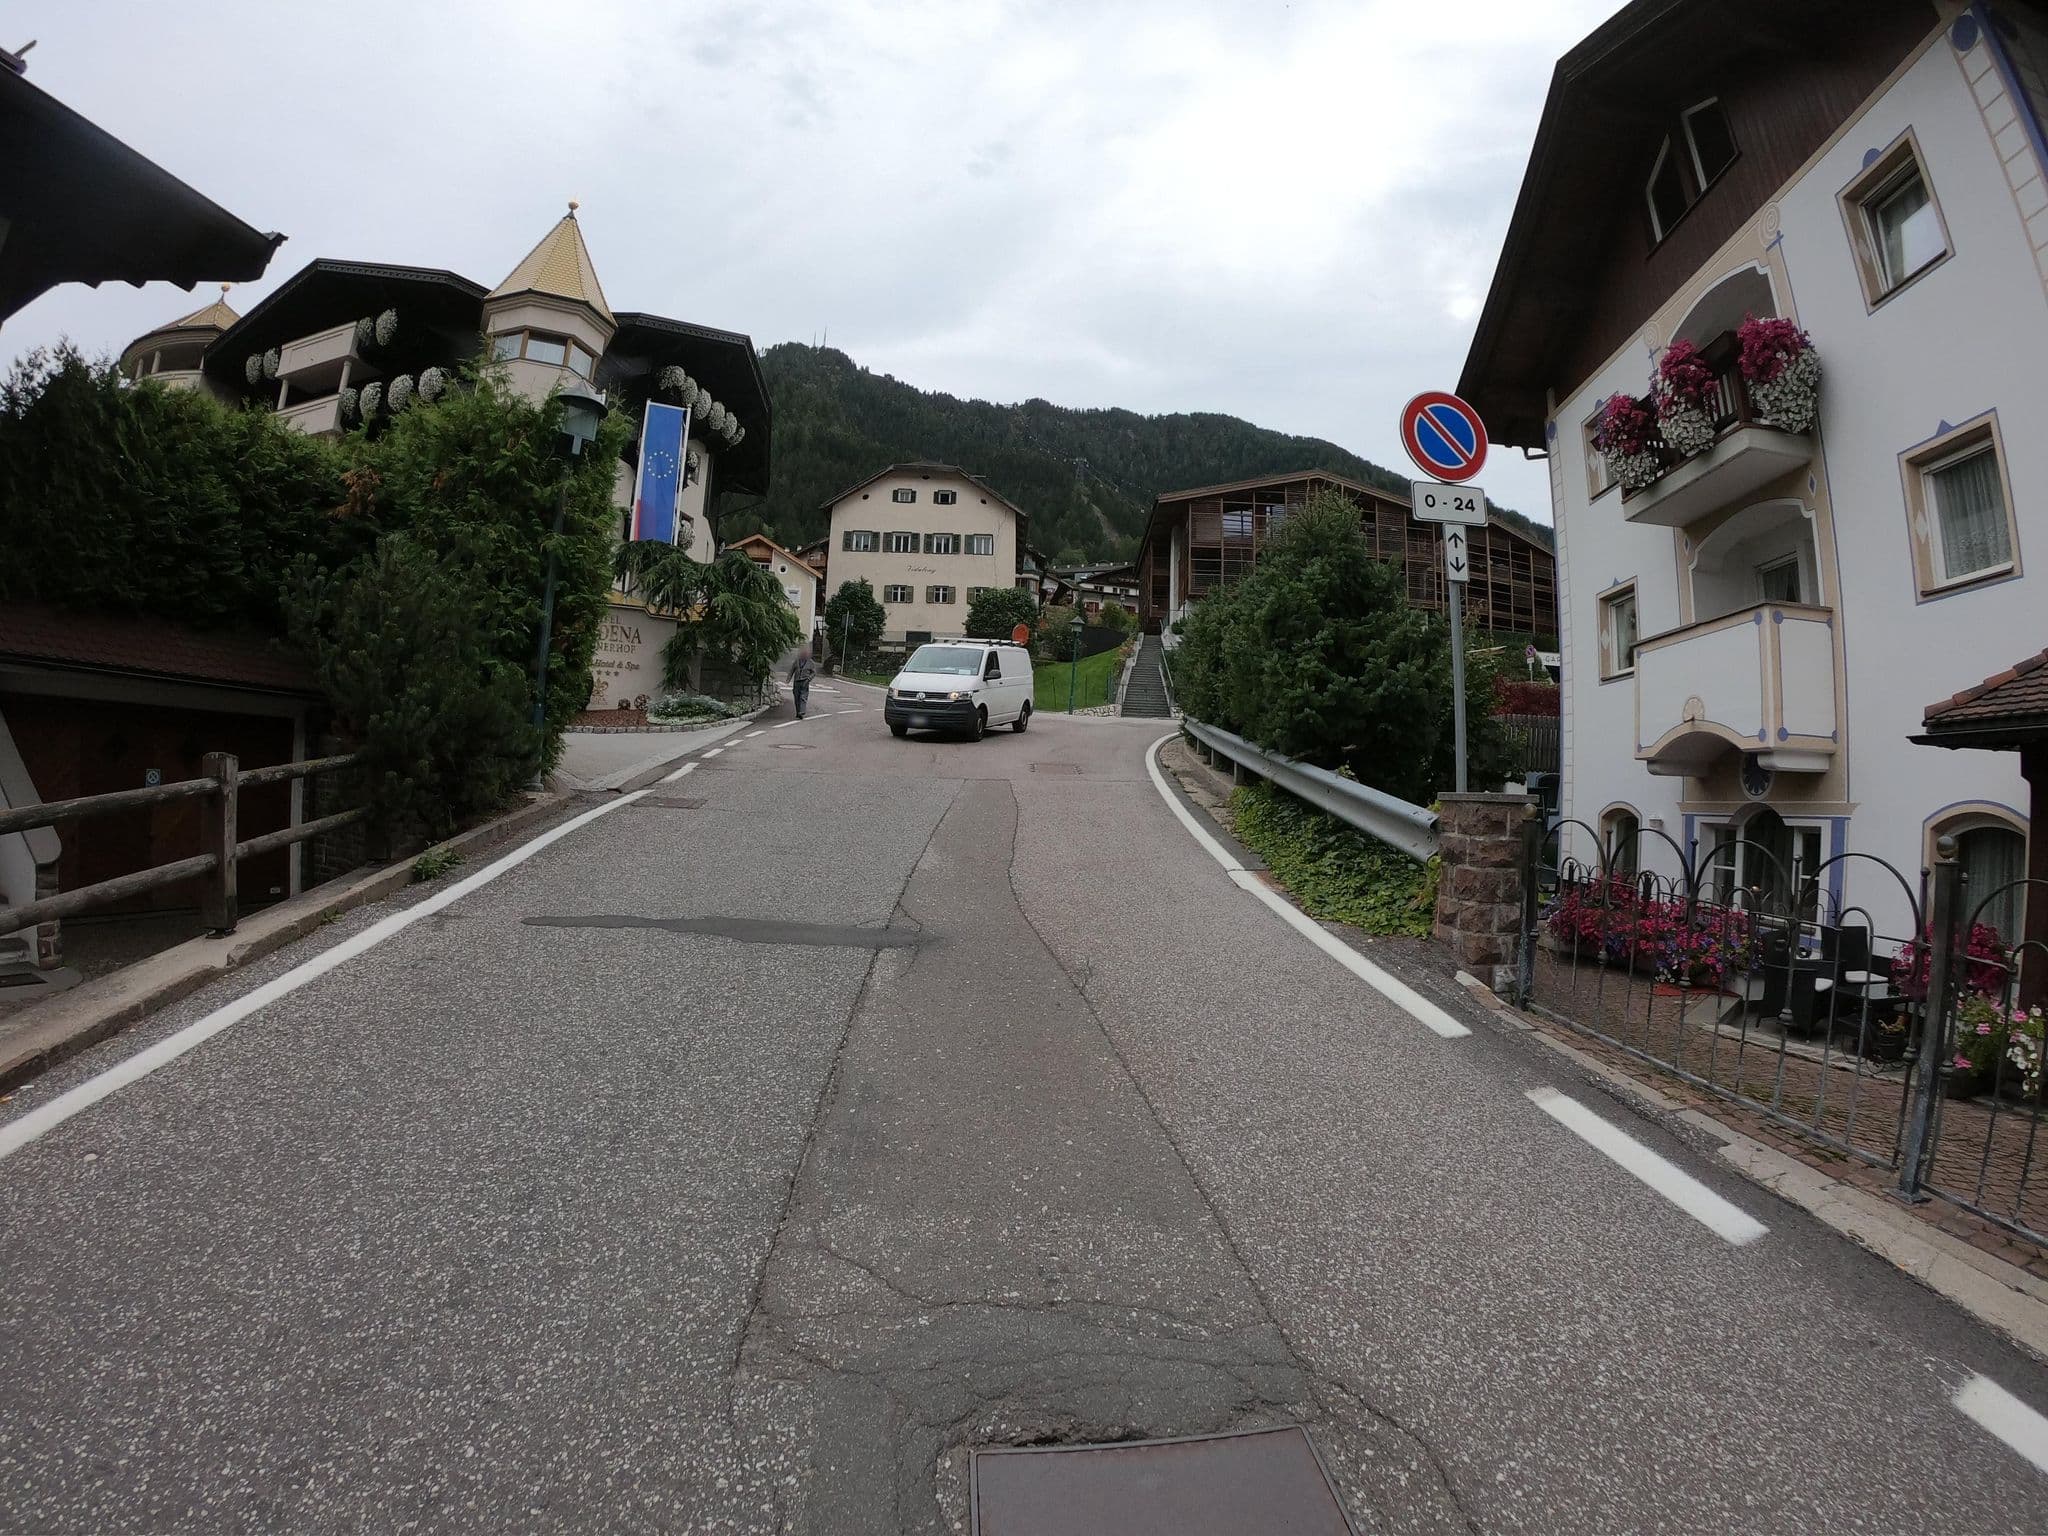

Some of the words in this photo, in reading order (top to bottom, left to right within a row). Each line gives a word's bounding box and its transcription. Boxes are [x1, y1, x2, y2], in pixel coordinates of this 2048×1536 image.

[1425, 494, 1436, 508] 0
[1453, 496, 1476, 512] 24
[625, 661, 641, 671] Spa
